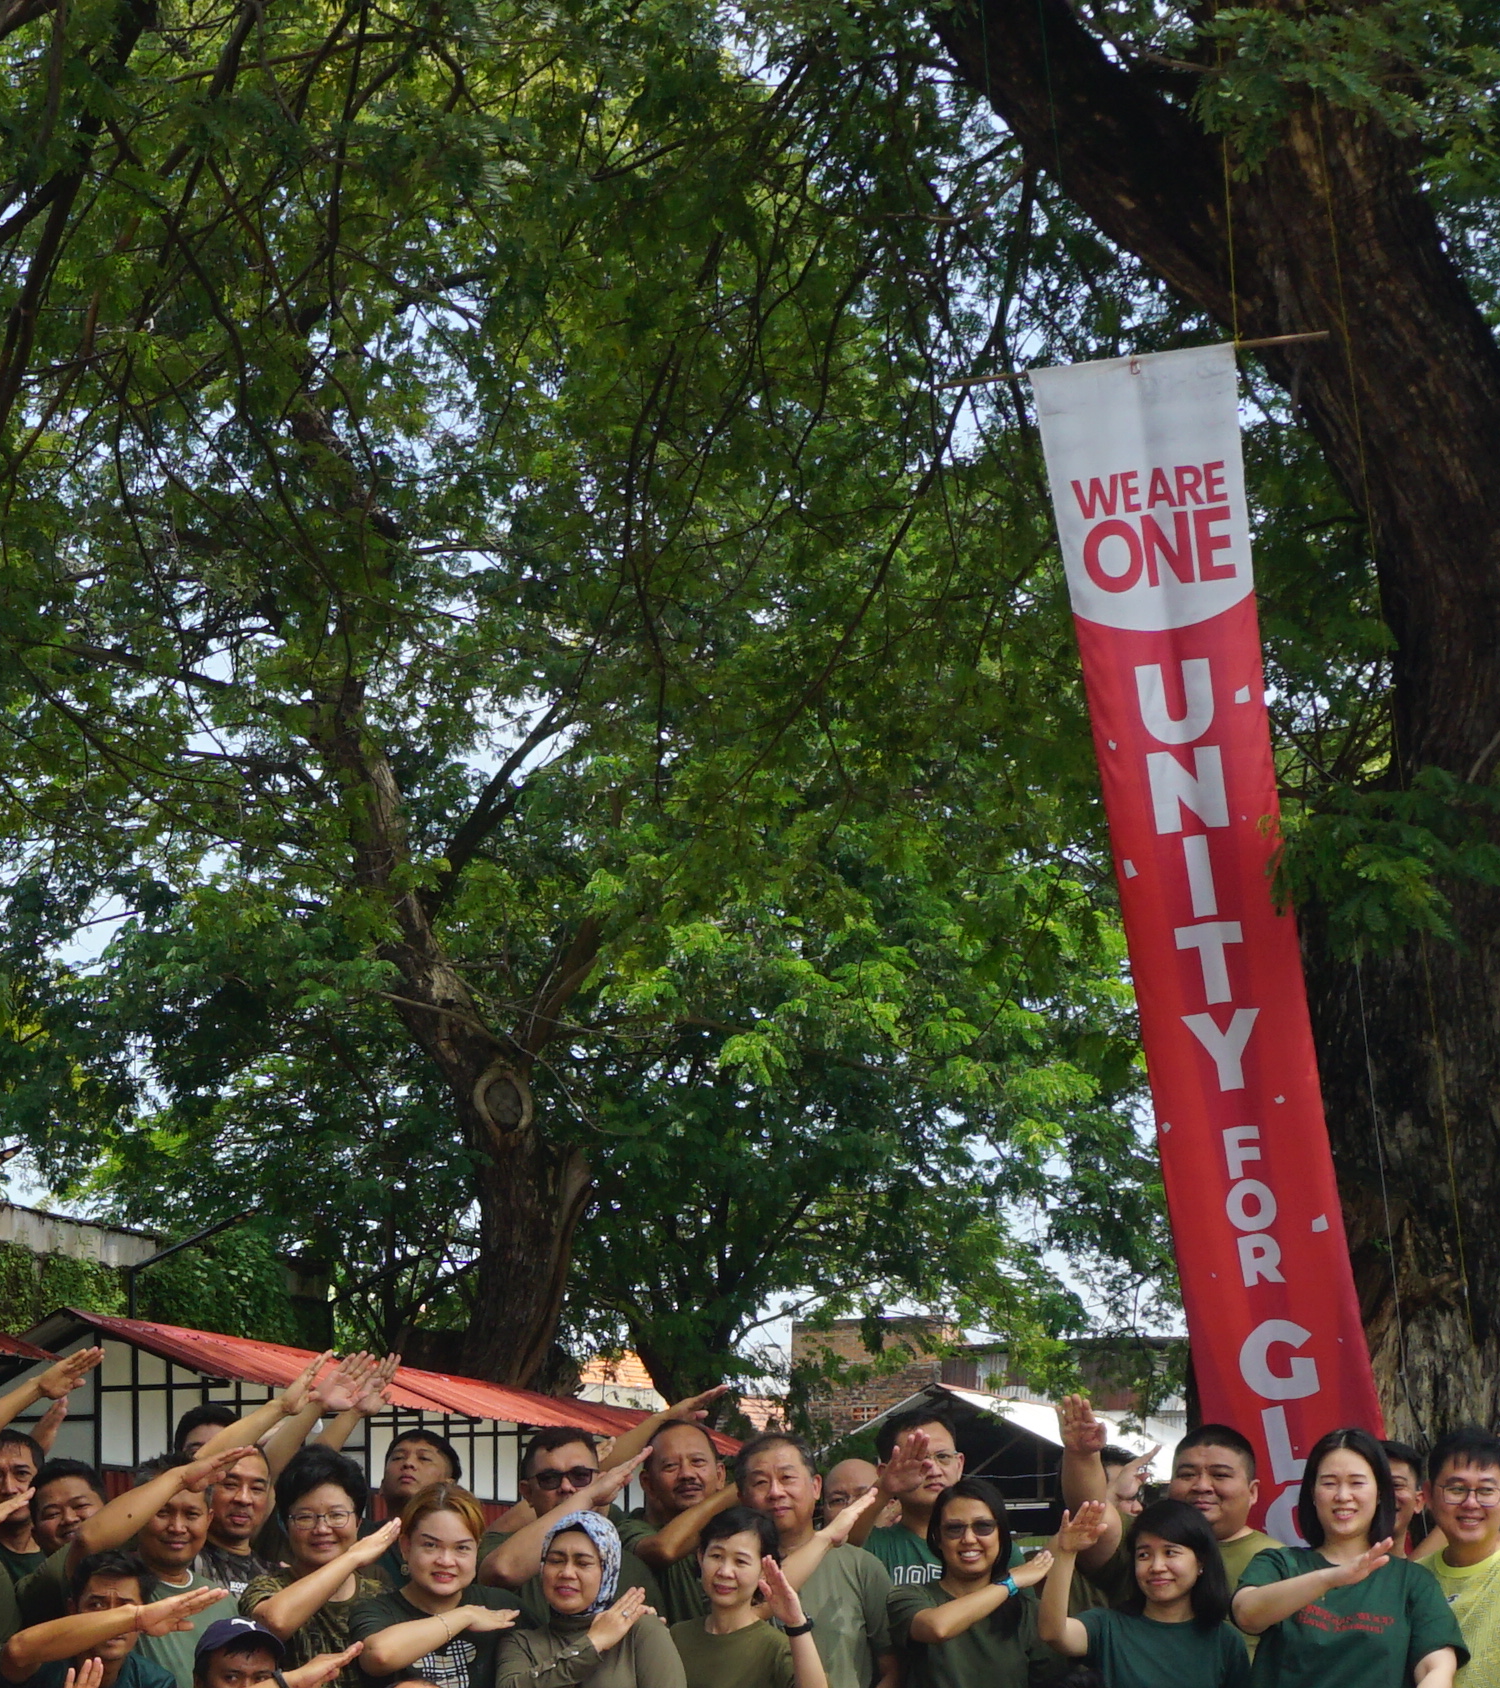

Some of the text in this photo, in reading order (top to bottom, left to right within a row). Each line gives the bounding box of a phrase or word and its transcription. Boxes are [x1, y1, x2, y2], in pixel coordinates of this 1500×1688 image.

[1070, 460, 1229, 520] WE ARE
[1083, 505, 1238, 594] ONE
[1134, 657, 1260, 1092] UNITY
[1222, 1125, 1287, 1288] FOR
